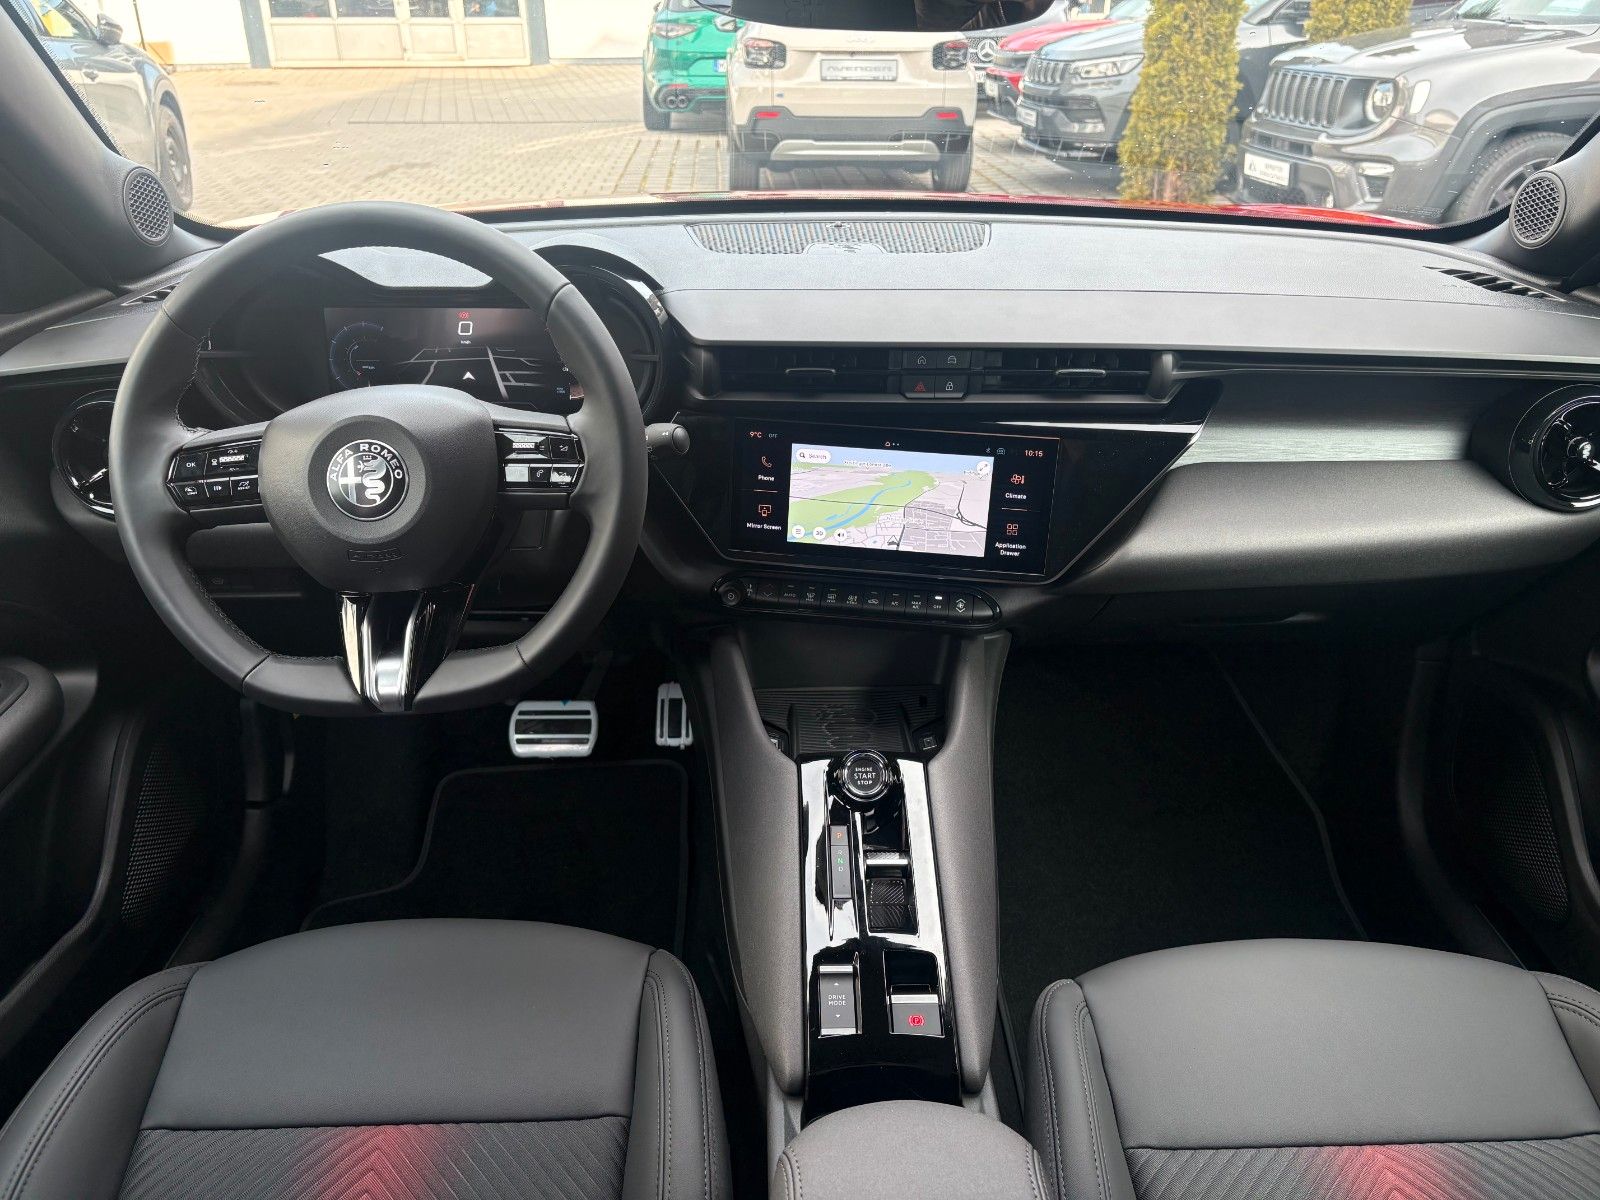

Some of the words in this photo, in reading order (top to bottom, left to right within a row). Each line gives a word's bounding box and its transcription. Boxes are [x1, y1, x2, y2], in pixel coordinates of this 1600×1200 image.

[1024, 449, 1043, 457] 10:15
[330, 448, 354, 481] ALFA
[359, 443, 403, 479] ROMEO
[1005, 492, 1027, 500] Climate
[763, 523, 782, 531] Screen
[995, 541, 1027, 550] Application
